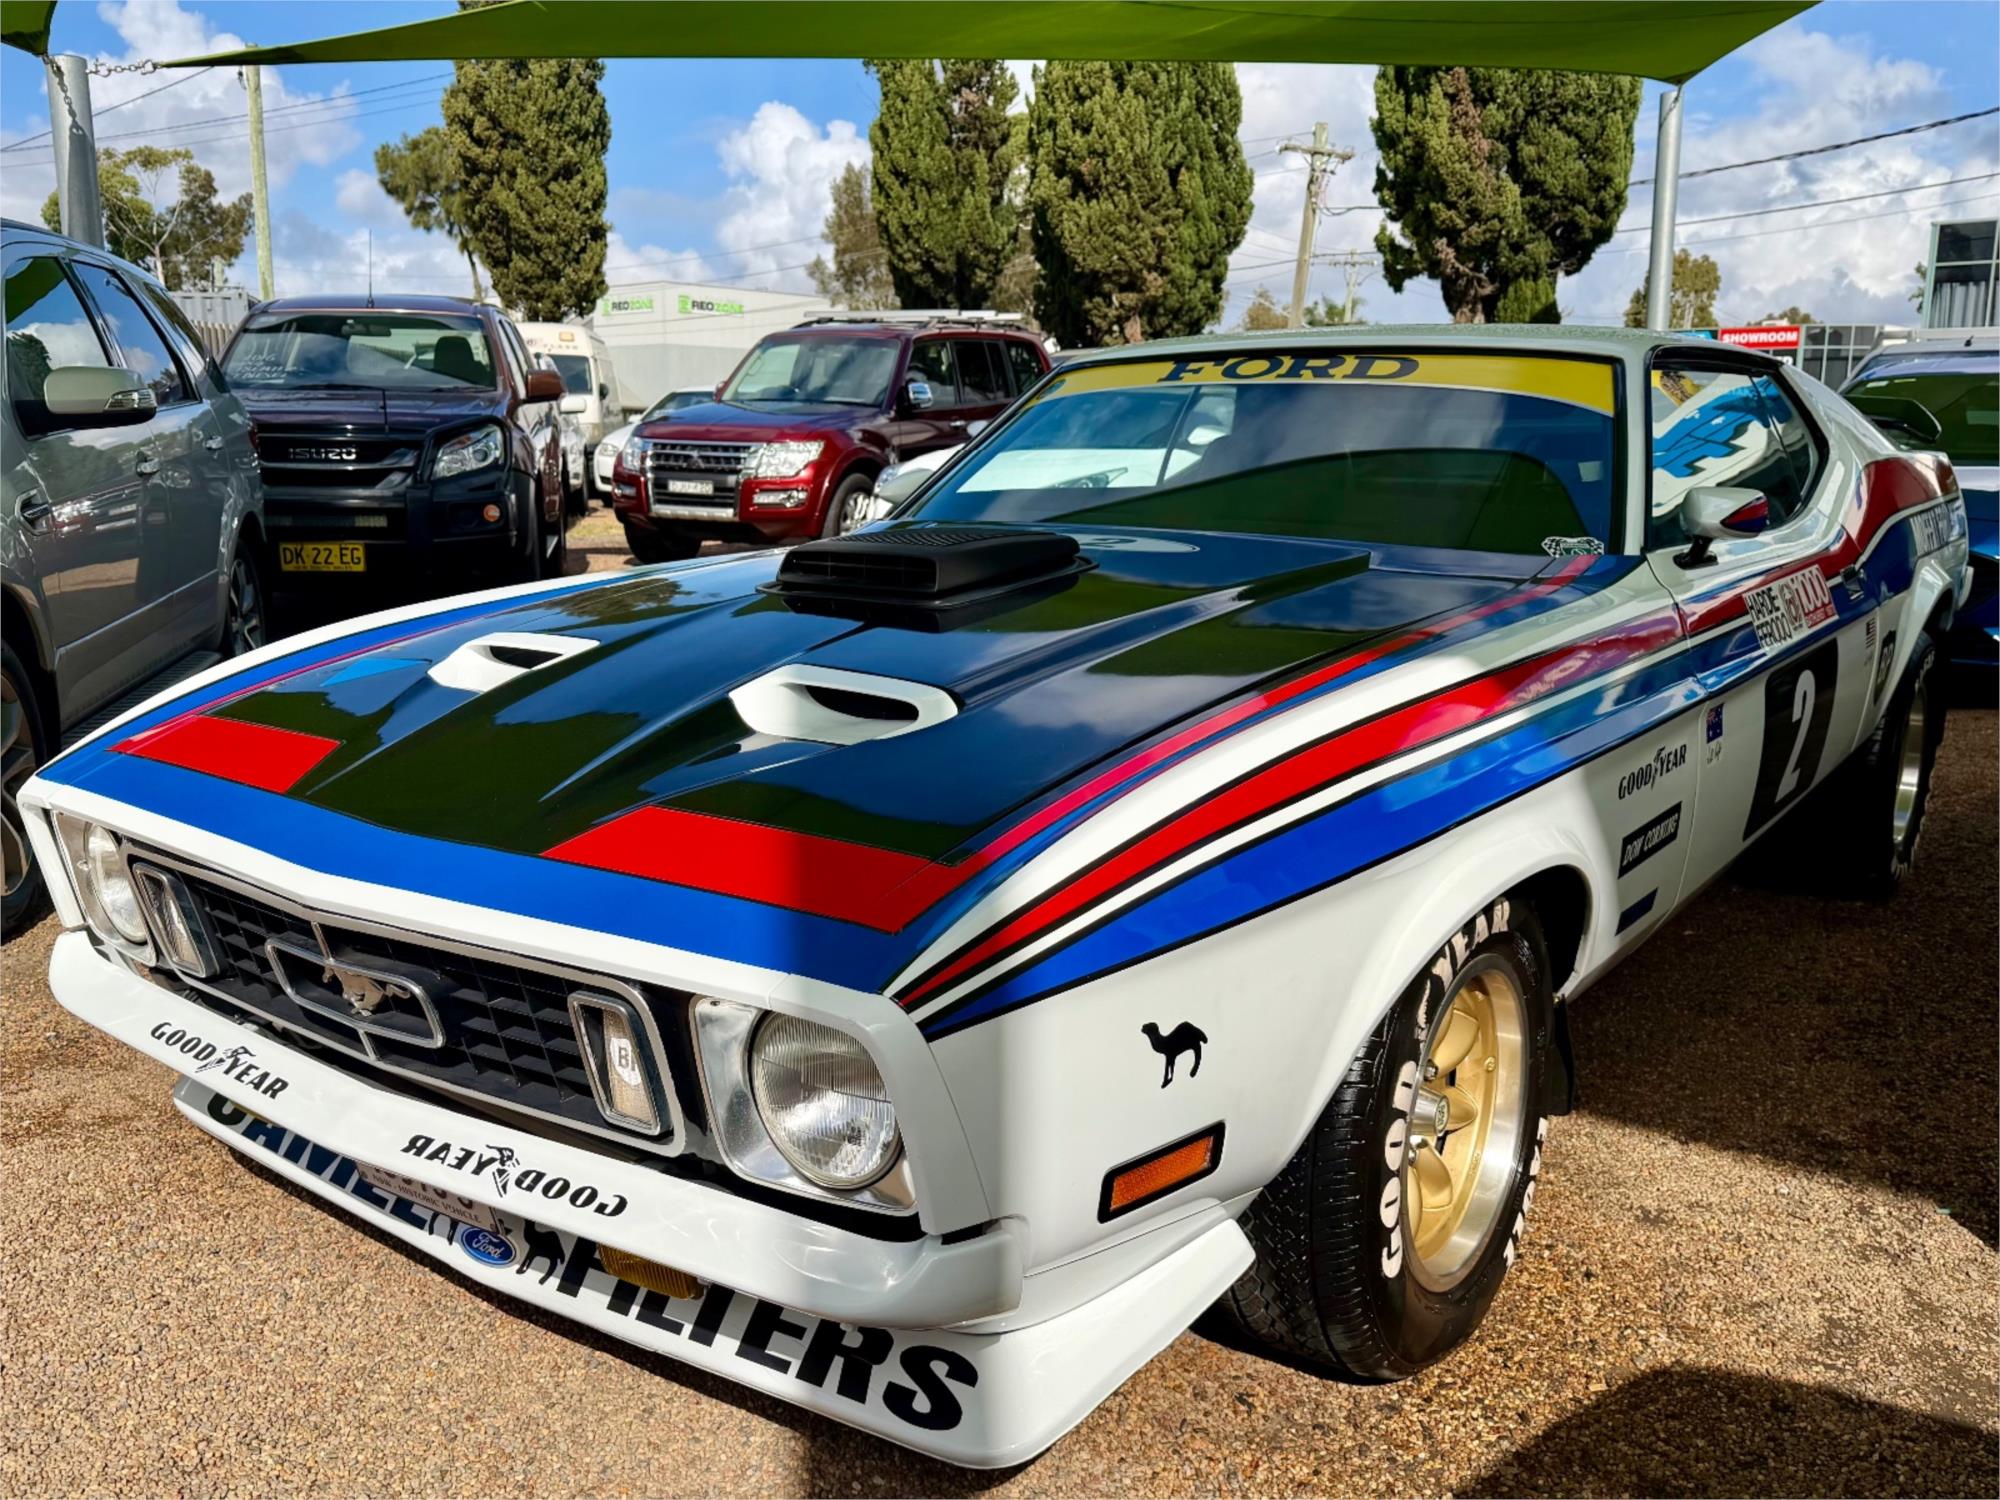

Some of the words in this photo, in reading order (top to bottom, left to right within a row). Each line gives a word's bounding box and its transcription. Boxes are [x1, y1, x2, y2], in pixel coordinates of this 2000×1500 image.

[1722, 331, 1798, 344] SHOWROOM
[1157, 355, 1420, 382] FORD
[288, 448, 357, 460] ISUZU
[282, 546, 306, 566] DK
[311, 547, 335, 566] 22
[339, 546, 362, 566] EG
[1775, 669, 1816, 803] 2
